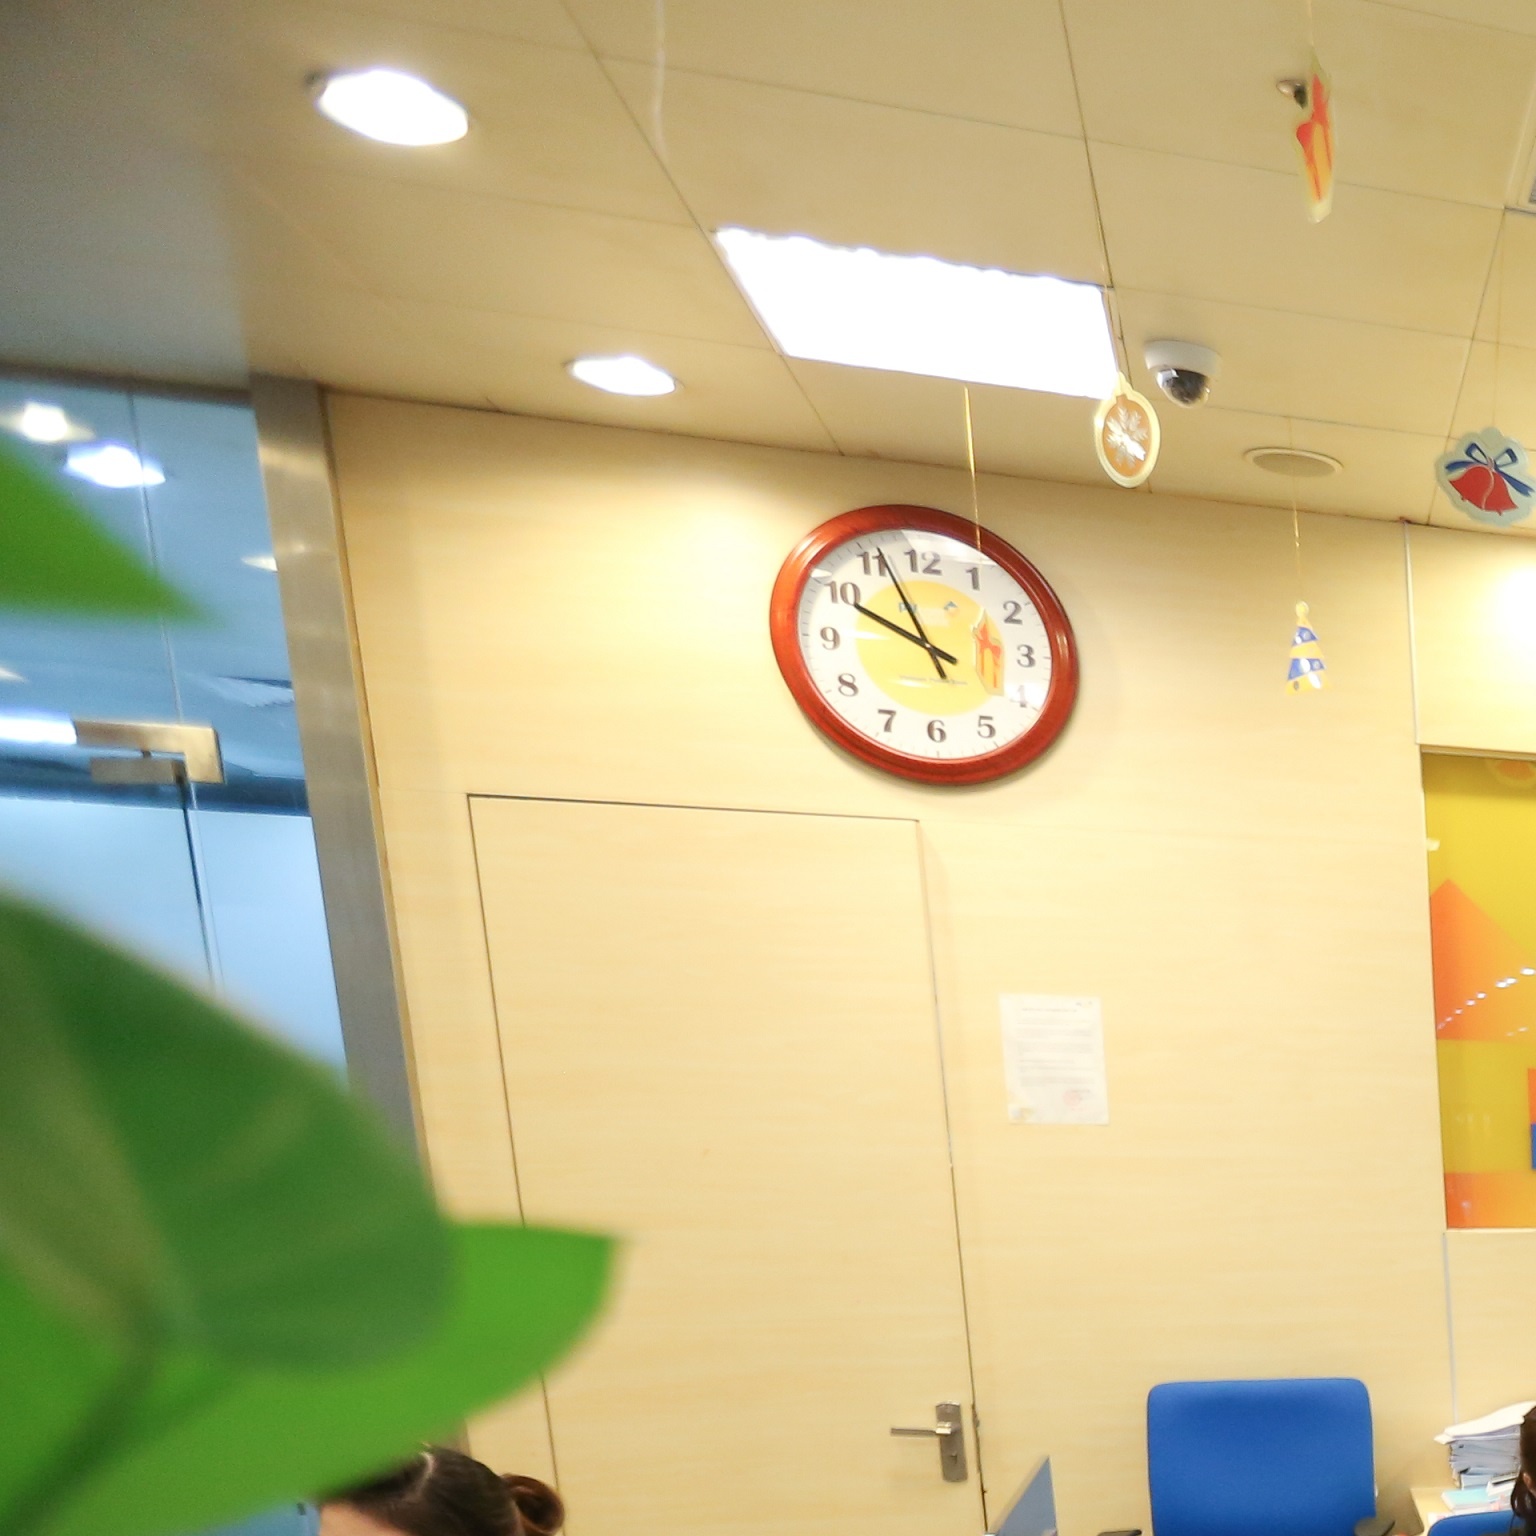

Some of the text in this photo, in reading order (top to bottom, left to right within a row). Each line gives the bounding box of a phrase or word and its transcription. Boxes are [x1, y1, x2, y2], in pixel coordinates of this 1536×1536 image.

[856, 551, 890, 578] 11
[903, 549, 942, 576] 12
[966, 567, 981, 591] 1
[826, 580, 862, 606] 10
[1002, 600, 1023, 625] 2
[819, 626, 841, 650] 9
[1016, 644, 1036, 668] 3
[837, 673, 859, 697] 8
[877, 708, 897, 733] 7
[926, 719, 947, 743] 6
[977, 715, 996, 739] 5
